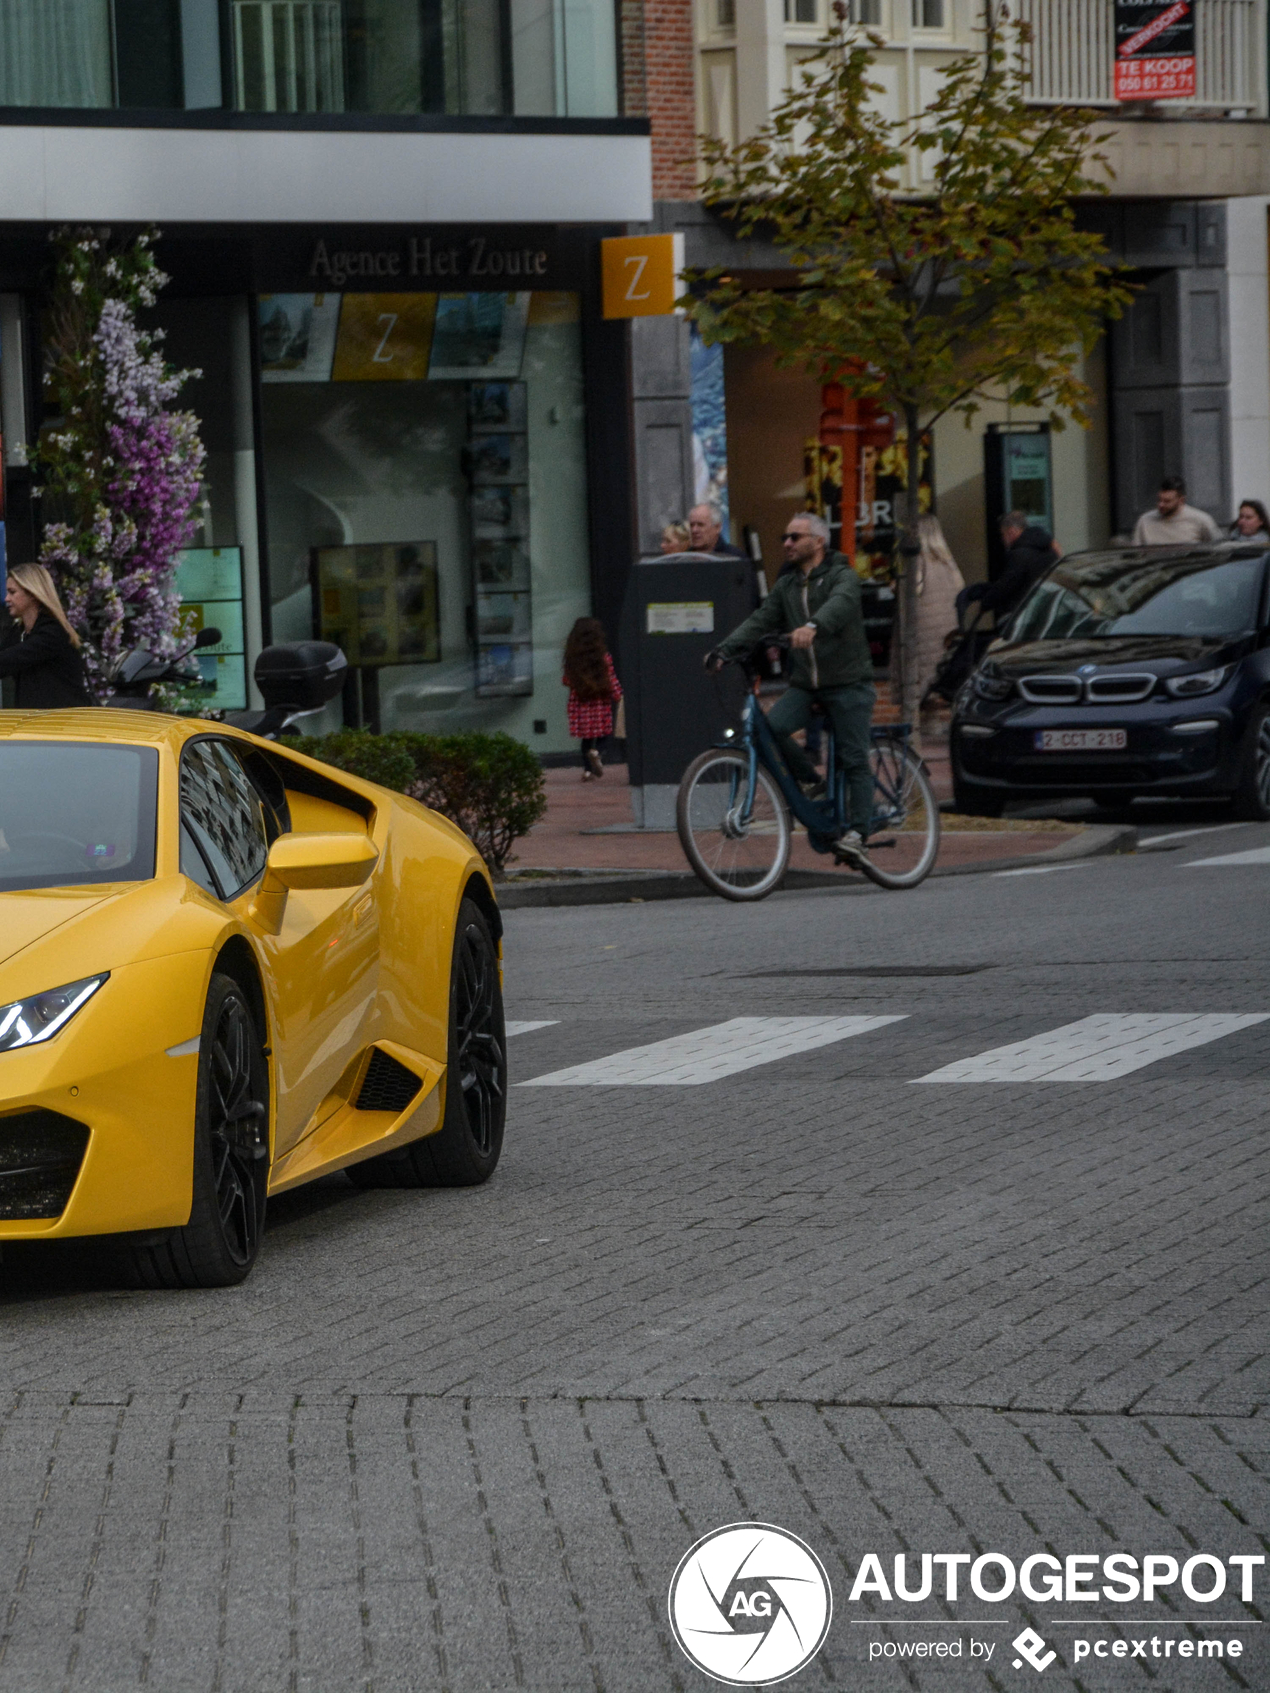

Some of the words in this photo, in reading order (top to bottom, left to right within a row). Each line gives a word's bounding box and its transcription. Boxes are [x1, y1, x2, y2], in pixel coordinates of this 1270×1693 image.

[1118, 76, 1141, 91] 050
[1143, 75, 1158, 90] 61
[1178, 73, 1193, 87] 71
[1119, 61, 1141, 75] TE
[1144, 58, 1193, 74] KOOP
[309, 238, 401, 286] Agence
[408, 237, 460, 276] Het
[467, 238, 548, 276] Zoute
[624, 255, 651, 300] Z
[371, 312, 399, 363] Z
